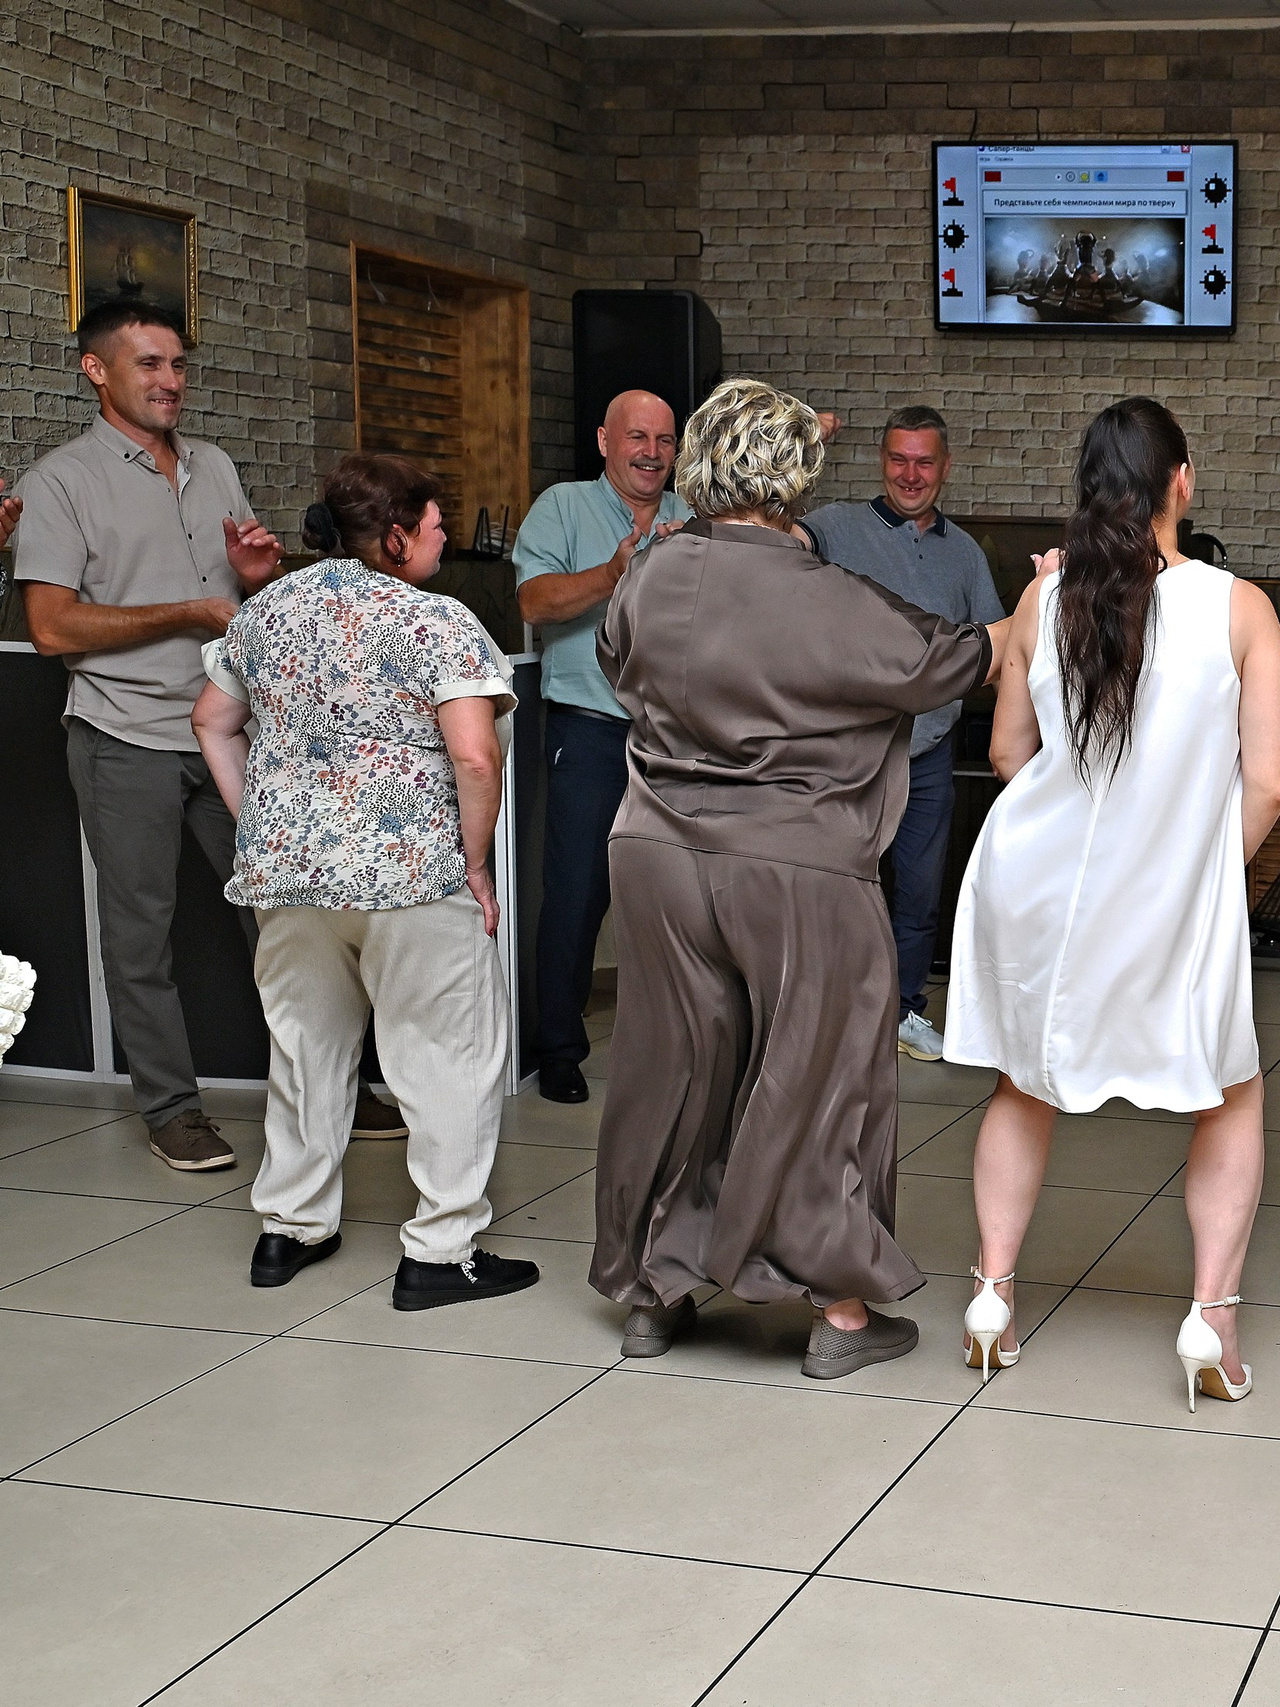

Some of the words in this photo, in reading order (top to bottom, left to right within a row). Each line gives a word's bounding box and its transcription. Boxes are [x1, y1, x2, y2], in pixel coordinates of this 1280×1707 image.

[994, 198, 1042, 208] Представьте
[1043, 197, 1062, 207] себя
[1063, 199, 1114, 207] чемпионами
[1115, 199, 1137, 208] мира
[1137, 199, 1148, 207] по
[1149, 199, 1176, 209] тверку
